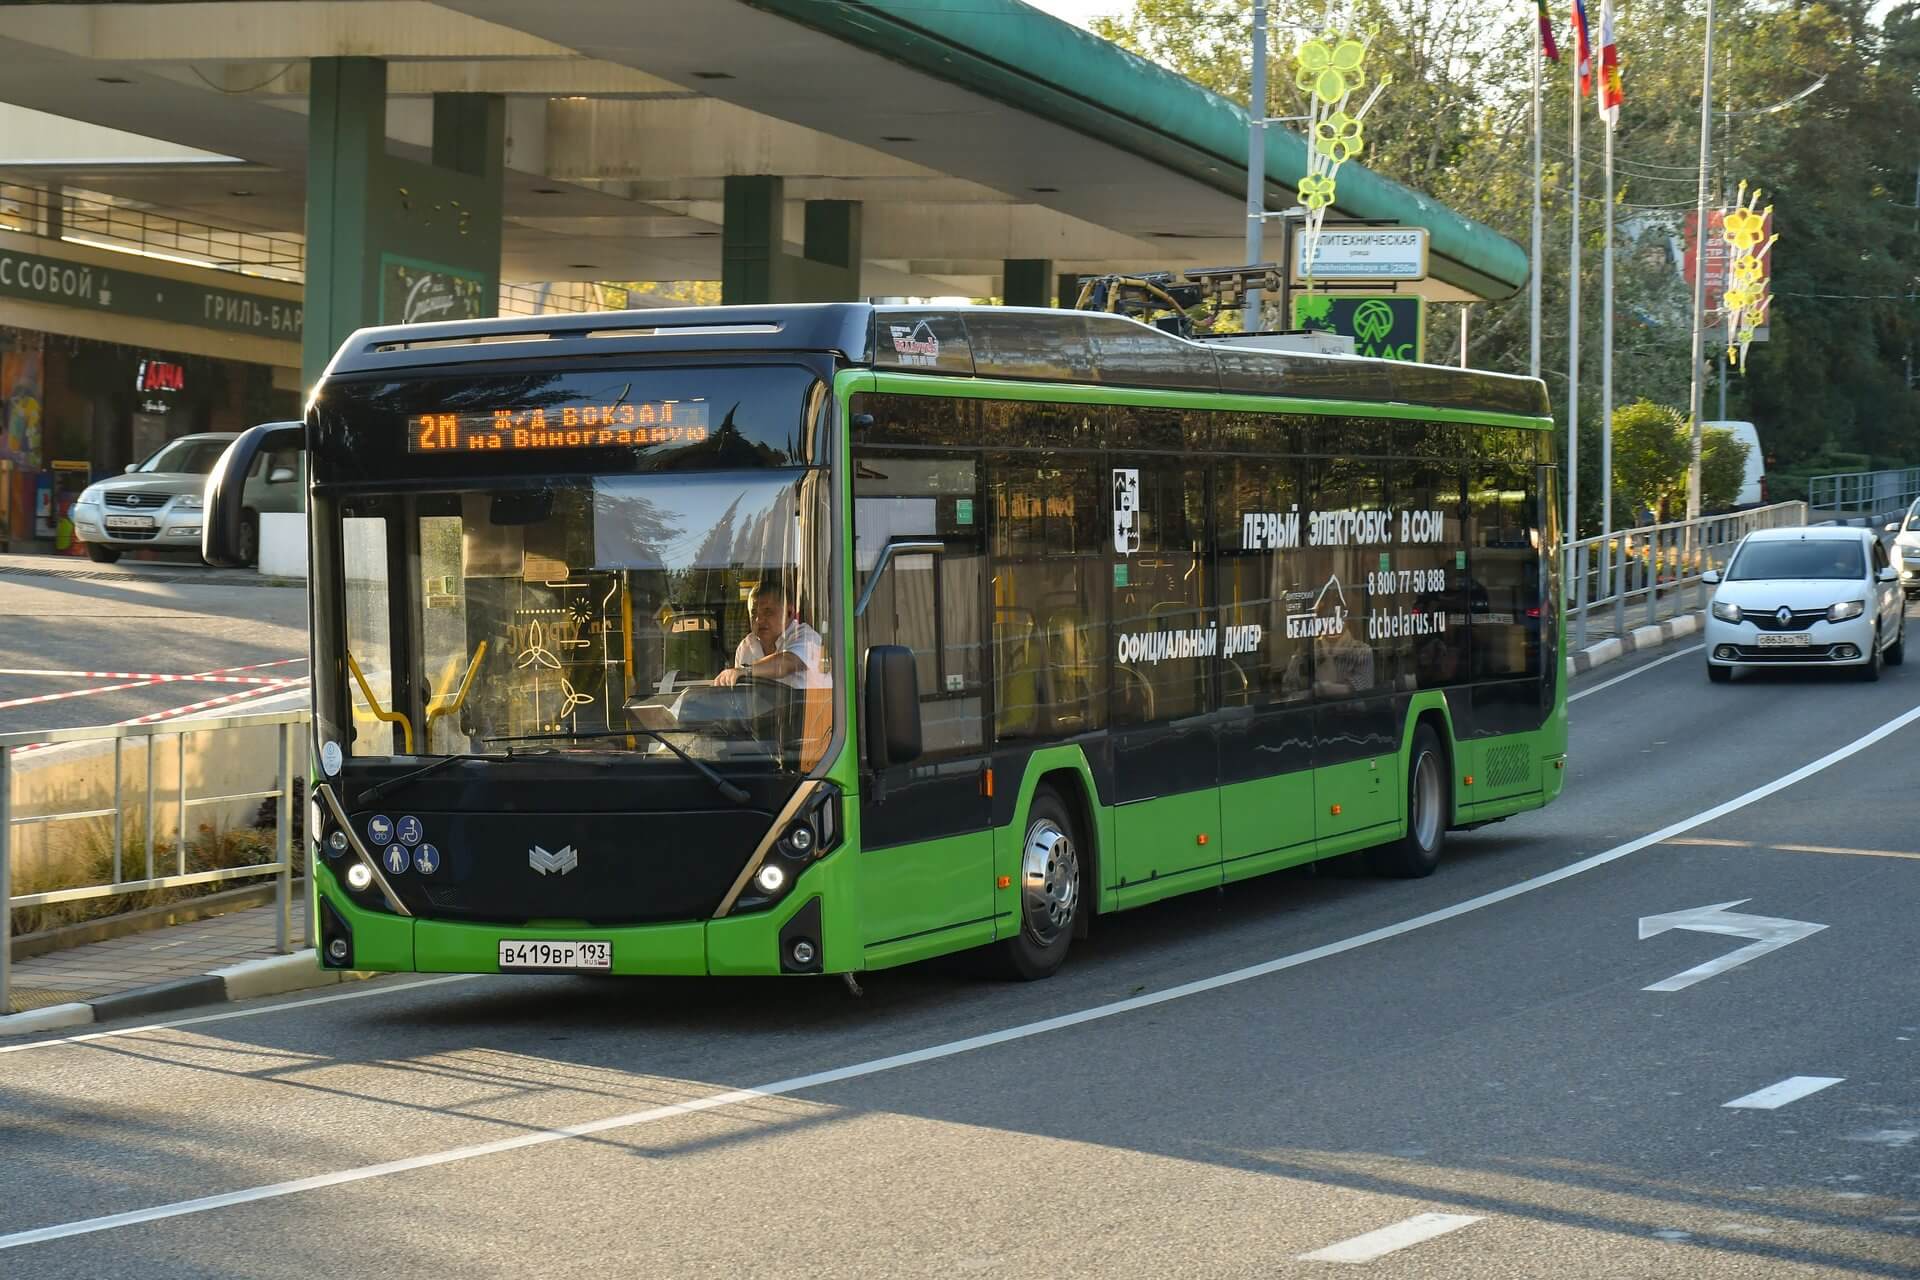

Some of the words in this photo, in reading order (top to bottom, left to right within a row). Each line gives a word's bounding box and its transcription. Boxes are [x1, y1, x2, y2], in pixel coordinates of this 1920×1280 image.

[18, 260, 92, 300] СОБОЙ
[203, 293, 303, 333] ГРИЛЬ-БАР
[563, 403, 674, 427] ВОКЗАЛ
[469, 432, 502, 449] на
[514, 425, 706, 448] Виноградную
[1243, 504, 1300, 550] ПЕРВЫЙ
[1309, 509, 1392, 546] ЭЛЕКТРОБУС
[1401, 510, 1410, 543] В
[1412, 510, 1445, 543] СОЧИ
[1368, 571, 1375, 596] 8
[1377, 571, 1396, 595] 800
[1398, 570, 1411, 594] 77
[1413, 569, 1425, 593] 50
[1427, 568, 1445, 592] 888
[1369, 606, 1446, 640] dcbelarus.ru
[1118, 621, 1217, 665] ОФИЦИАЛЬНЫЙ
[1224, 624, 1262, 660] ДИЛЕР
[579, 944, 605, 959] 193
